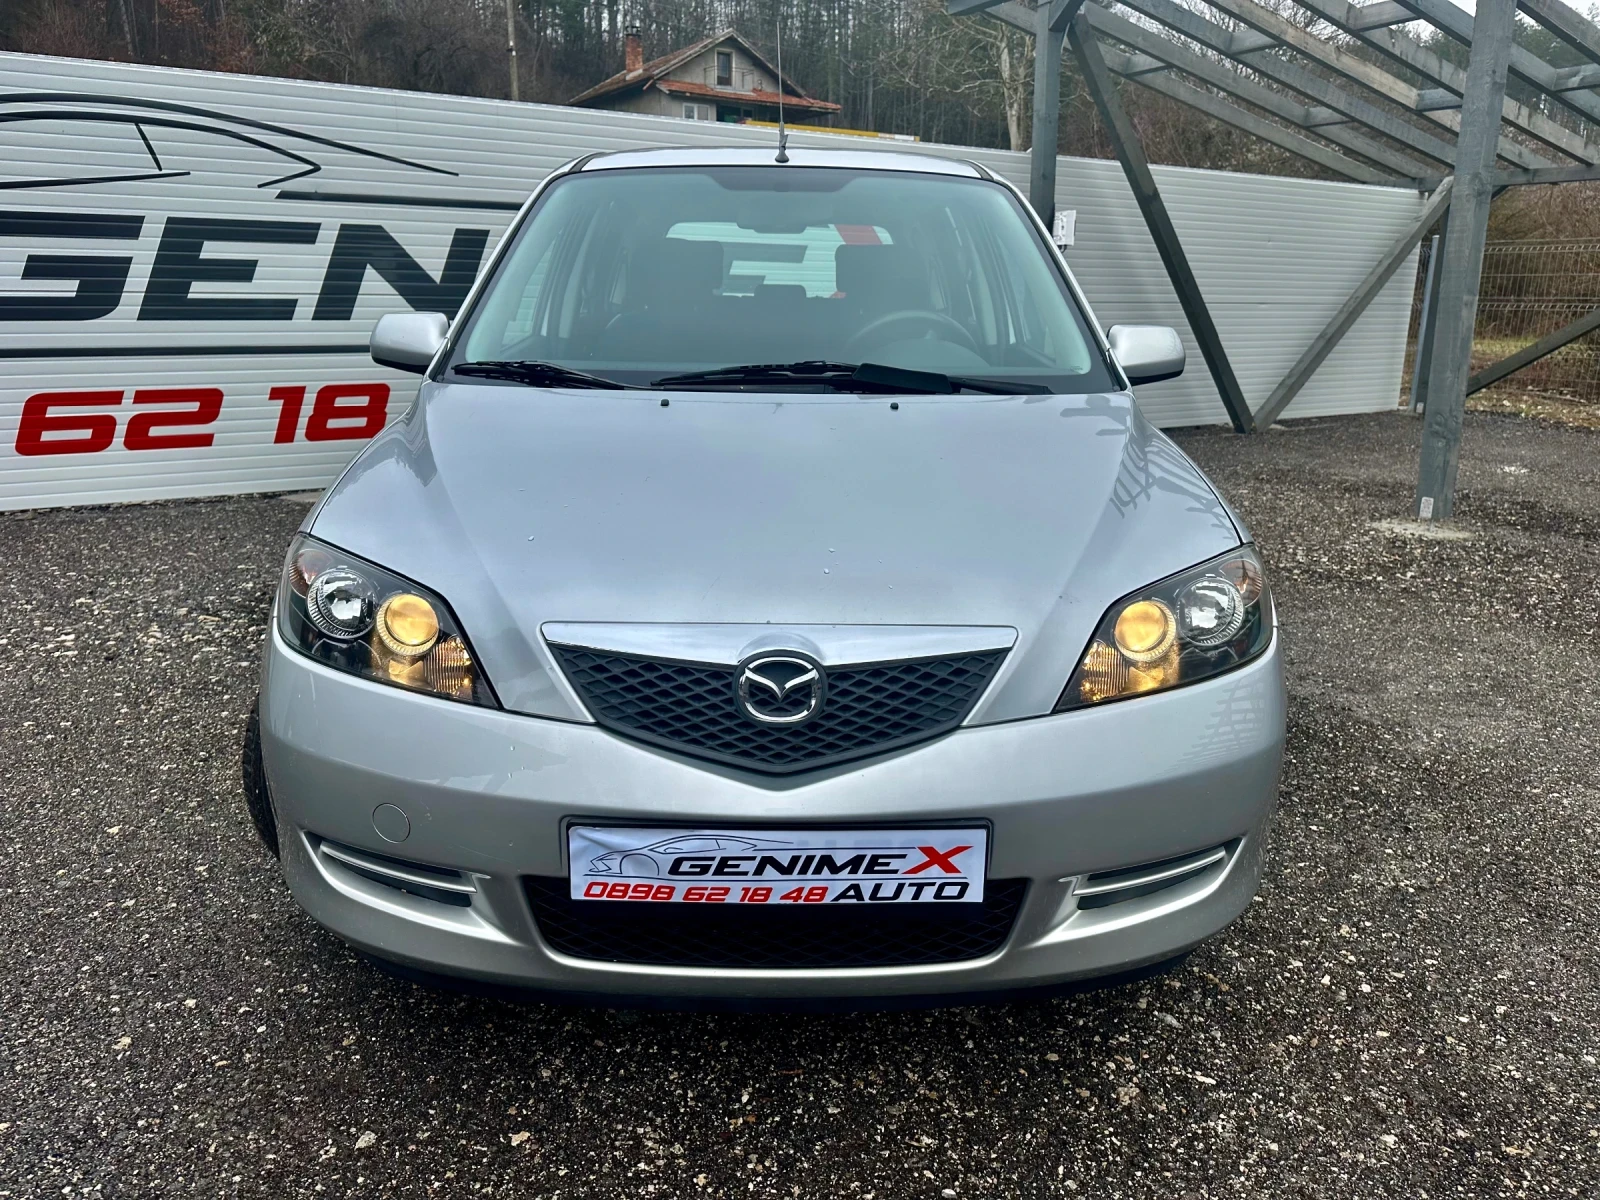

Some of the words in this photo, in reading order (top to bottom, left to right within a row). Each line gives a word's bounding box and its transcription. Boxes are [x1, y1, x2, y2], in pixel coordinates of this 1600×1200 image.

[14, 387, 224, 457] 62
[267, 383, 391, 445] 18
[667, 845, 975, 877] GENIMEX
[583, 881, 676, 901] 0898
[682, 886, 731, 902] 62
[739, 886, 774, 903] 18
[779, 886, 829, 903] 48
[830, 881, 970, 902] AUTO
